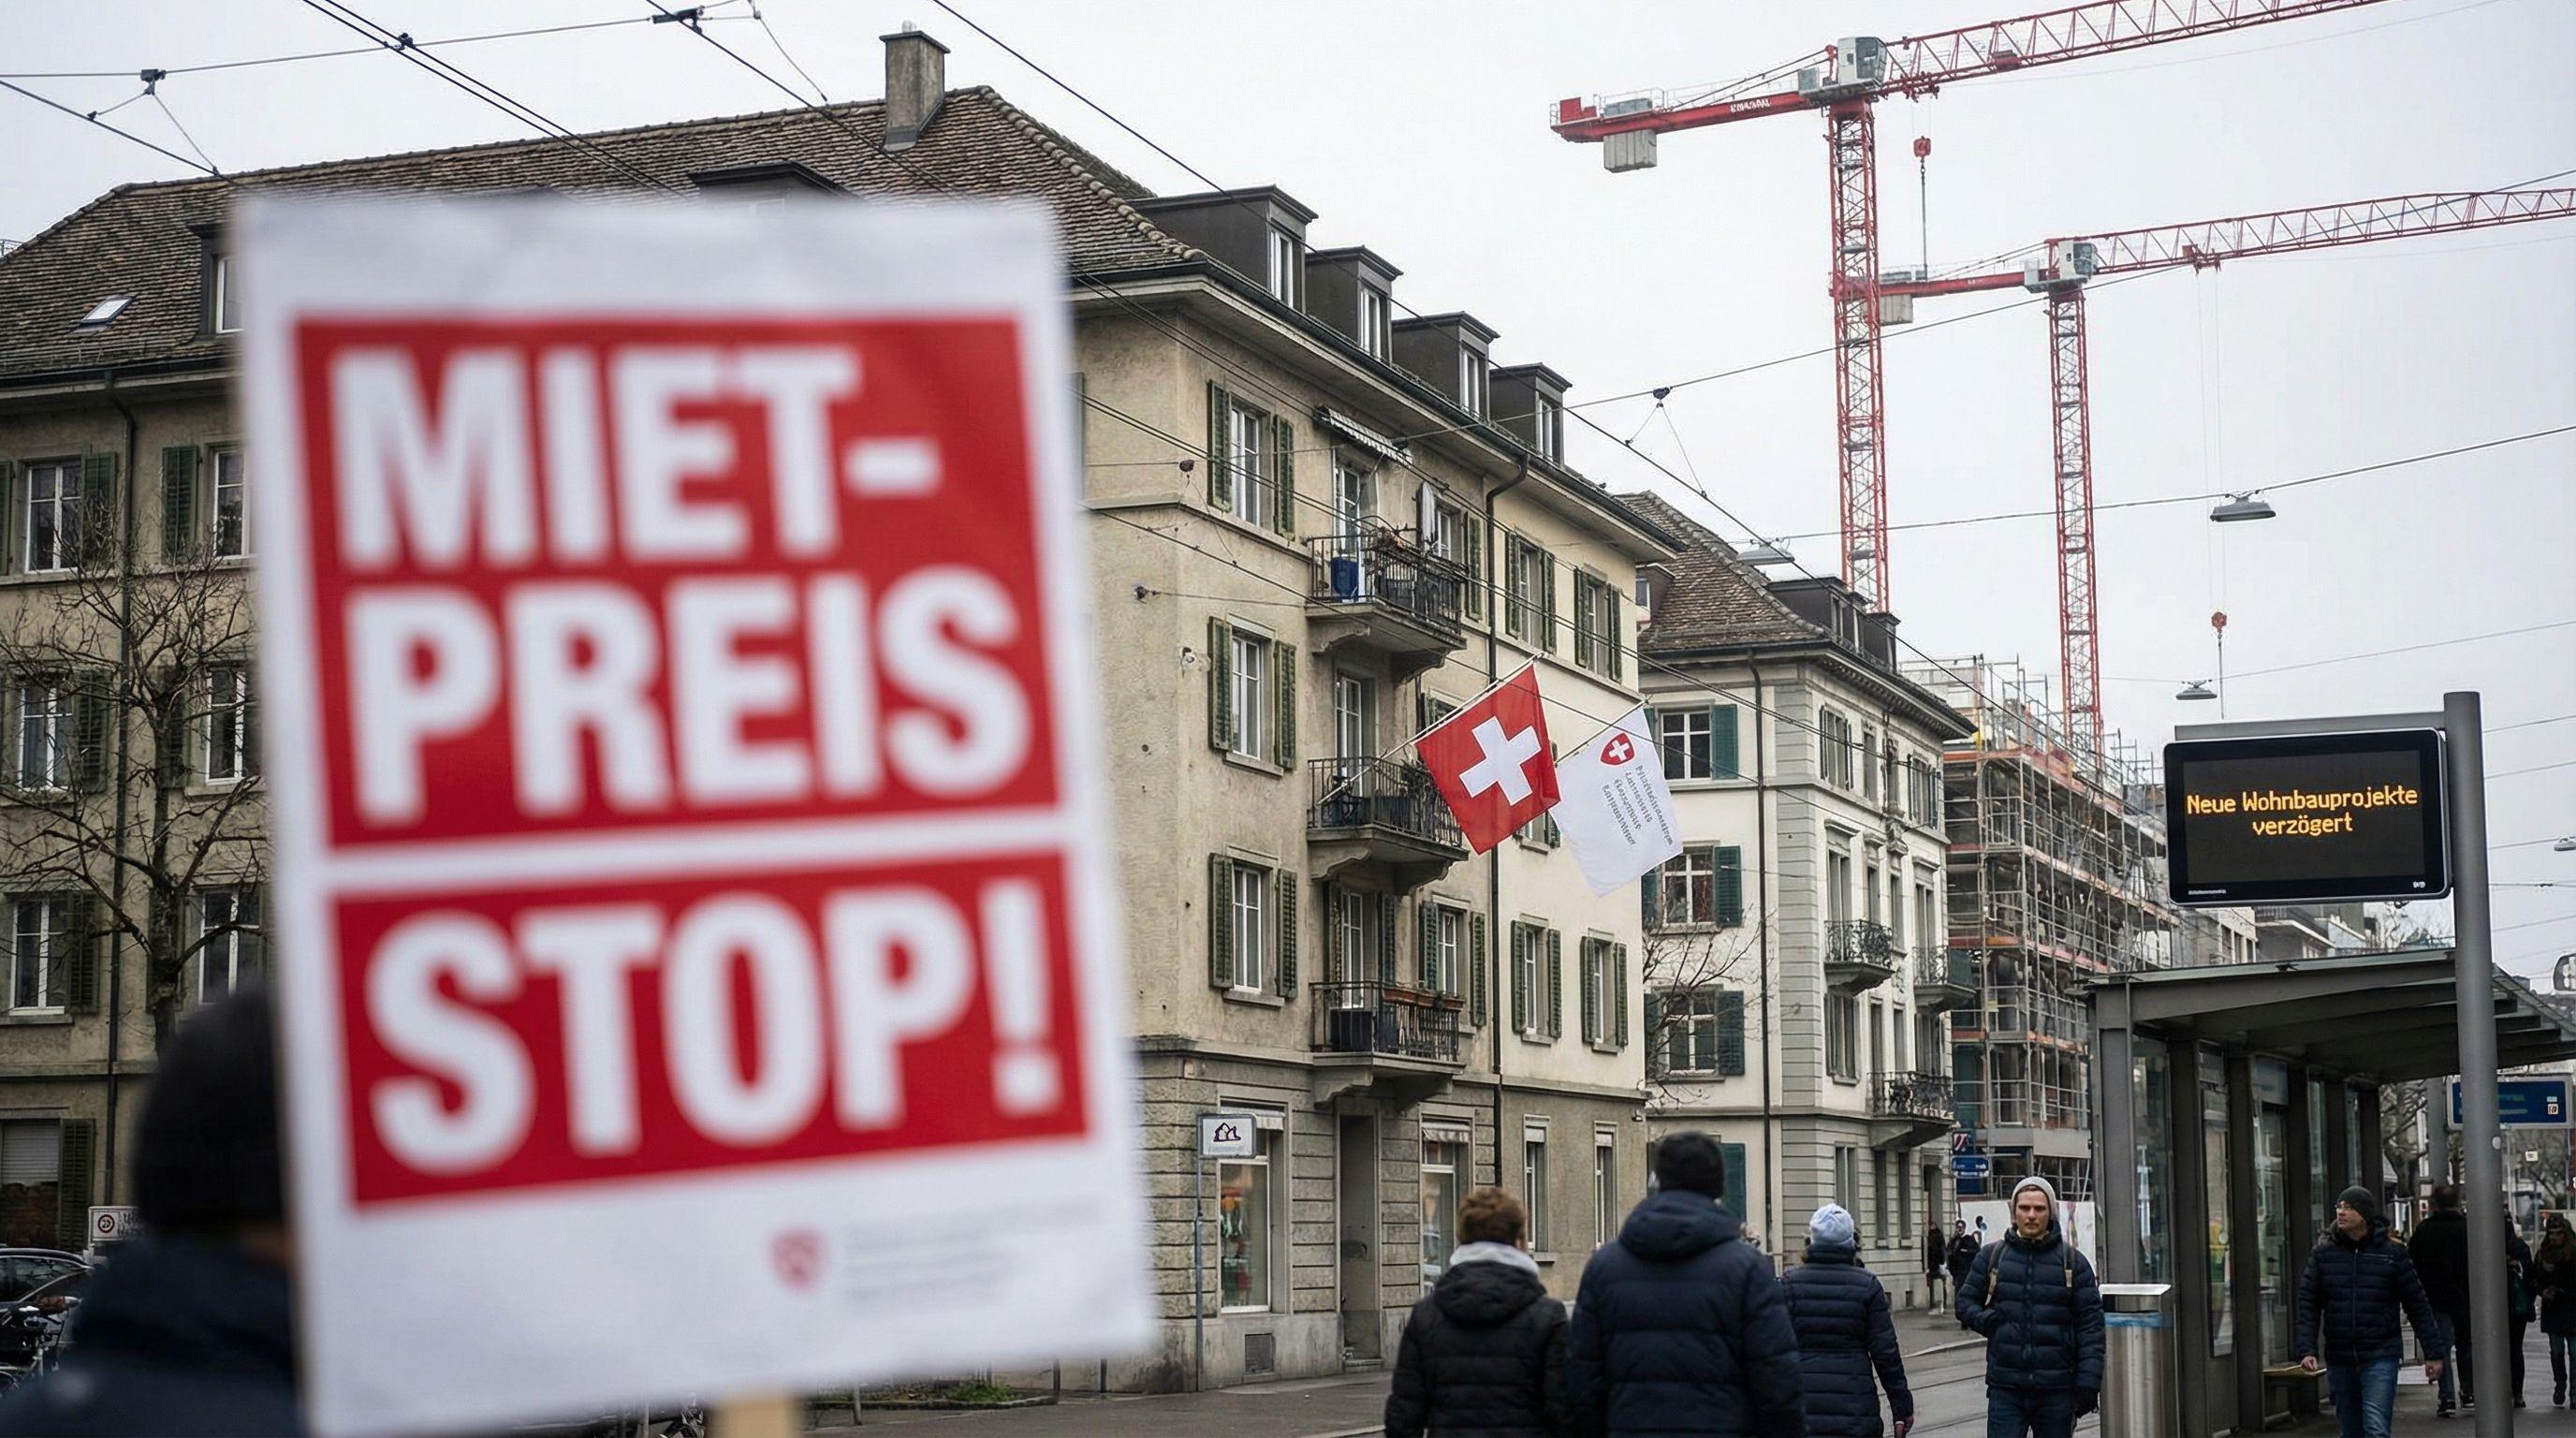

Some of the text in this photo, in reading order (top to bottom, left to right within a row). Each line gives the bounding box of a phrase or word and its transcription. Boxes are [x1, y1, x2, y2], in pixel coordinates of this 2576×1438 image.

[331, 346, 939, 565] MIET-
[346, 566, 1031, 819] PREIS
[2187, 785, 2418, 814] Neue Wohnbauprojekte
[2252, 812, 2353, 836] verzögert
[369, 880, 1060, 1167] STOP!
